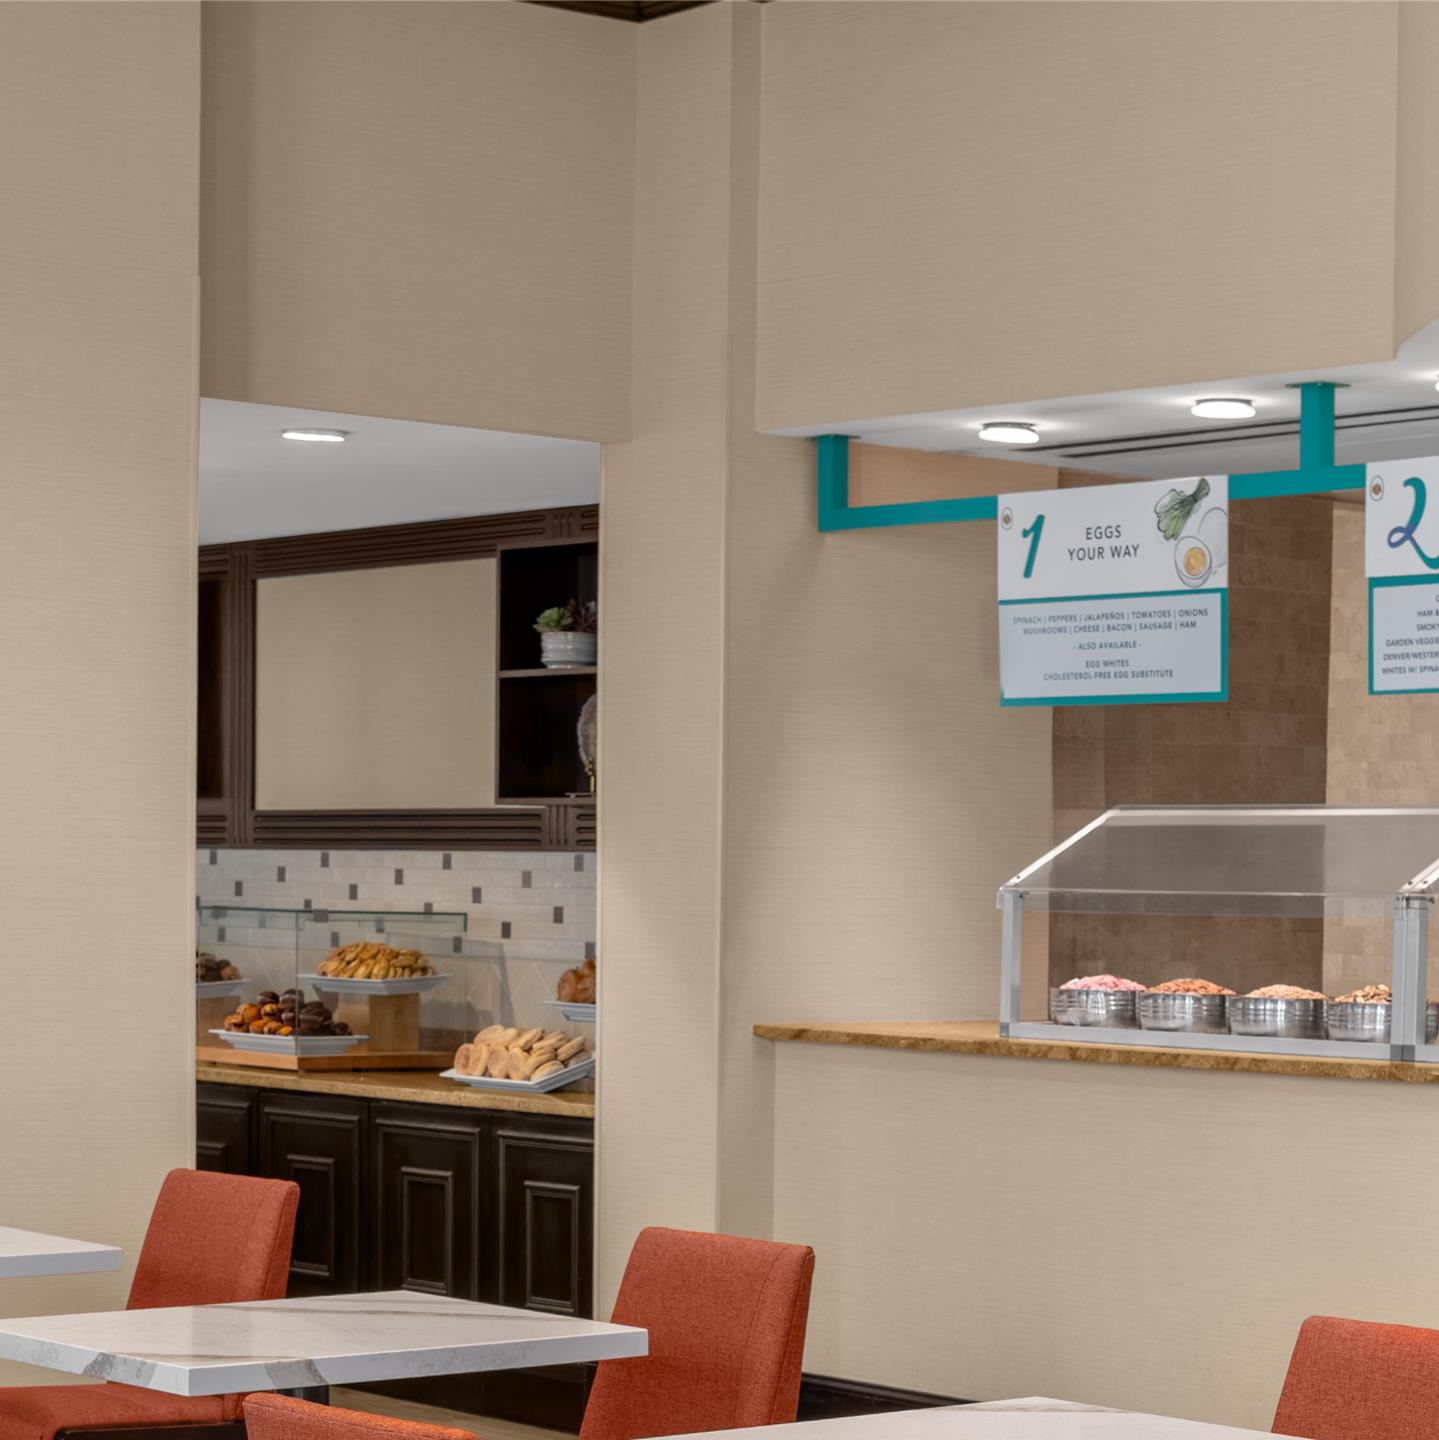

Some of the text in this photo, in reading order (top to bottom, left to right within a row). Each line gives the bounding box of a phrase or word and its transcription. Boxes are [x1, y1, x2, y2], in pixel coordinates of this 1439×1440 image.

[1086, 525, 1121, 541] EGGS
[1022, 514, 1045, 578] 1
[1068, 544, 1139, 561] YOUR WAY
[1012, 608, 1208, 624] SPINACH PEPPERS JALAPEÑOS TOMATOES ONIONS
[1417, 609, 1433, 617] HAM
[1023, 620, 1197, 634] MUSHROOMS CHEESE BACON SAUSAGE HAM
[1078, 640, 1137, 650] ALSO AVAILABLE
[1385, 638, 1414, 647] GARDEN
[1415, 637, 1439, 645] VEGGIE
[1086, 659, 1129, 668] EGG WHITES
[1043, 669, 1174, 681] CHOLESTEROL-FREE EGG SUBSTITUTE
[1382, 666, 1406, 674] WHITES
